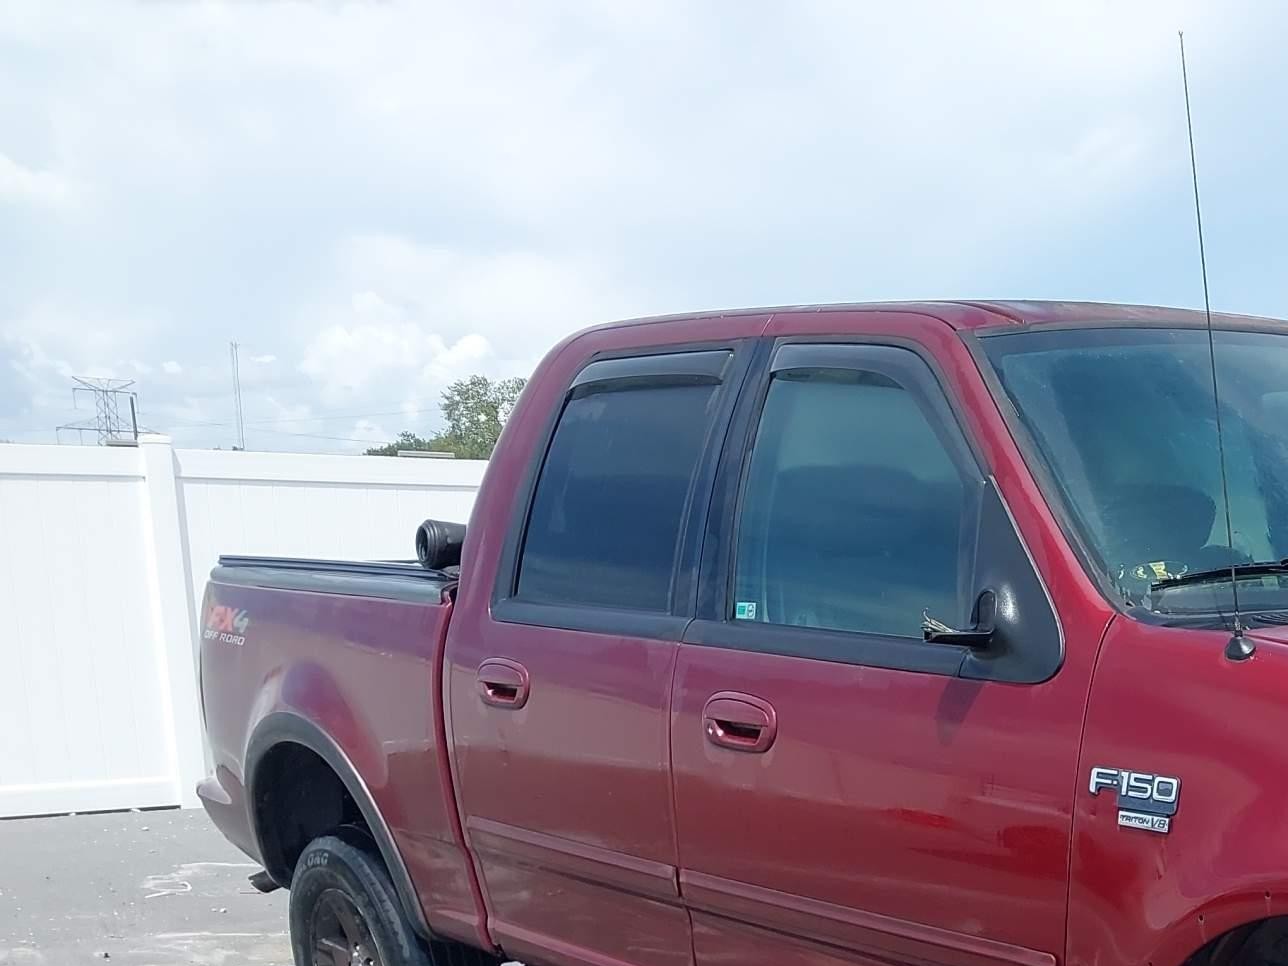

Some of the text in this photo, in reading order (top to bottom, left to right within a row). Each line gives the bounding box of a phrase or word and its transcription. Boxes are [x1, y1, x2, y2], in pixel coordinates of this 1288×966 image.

[219, 632, 246, 646] ROAD
[1119, 814, 1168, 829] TRITON V8
